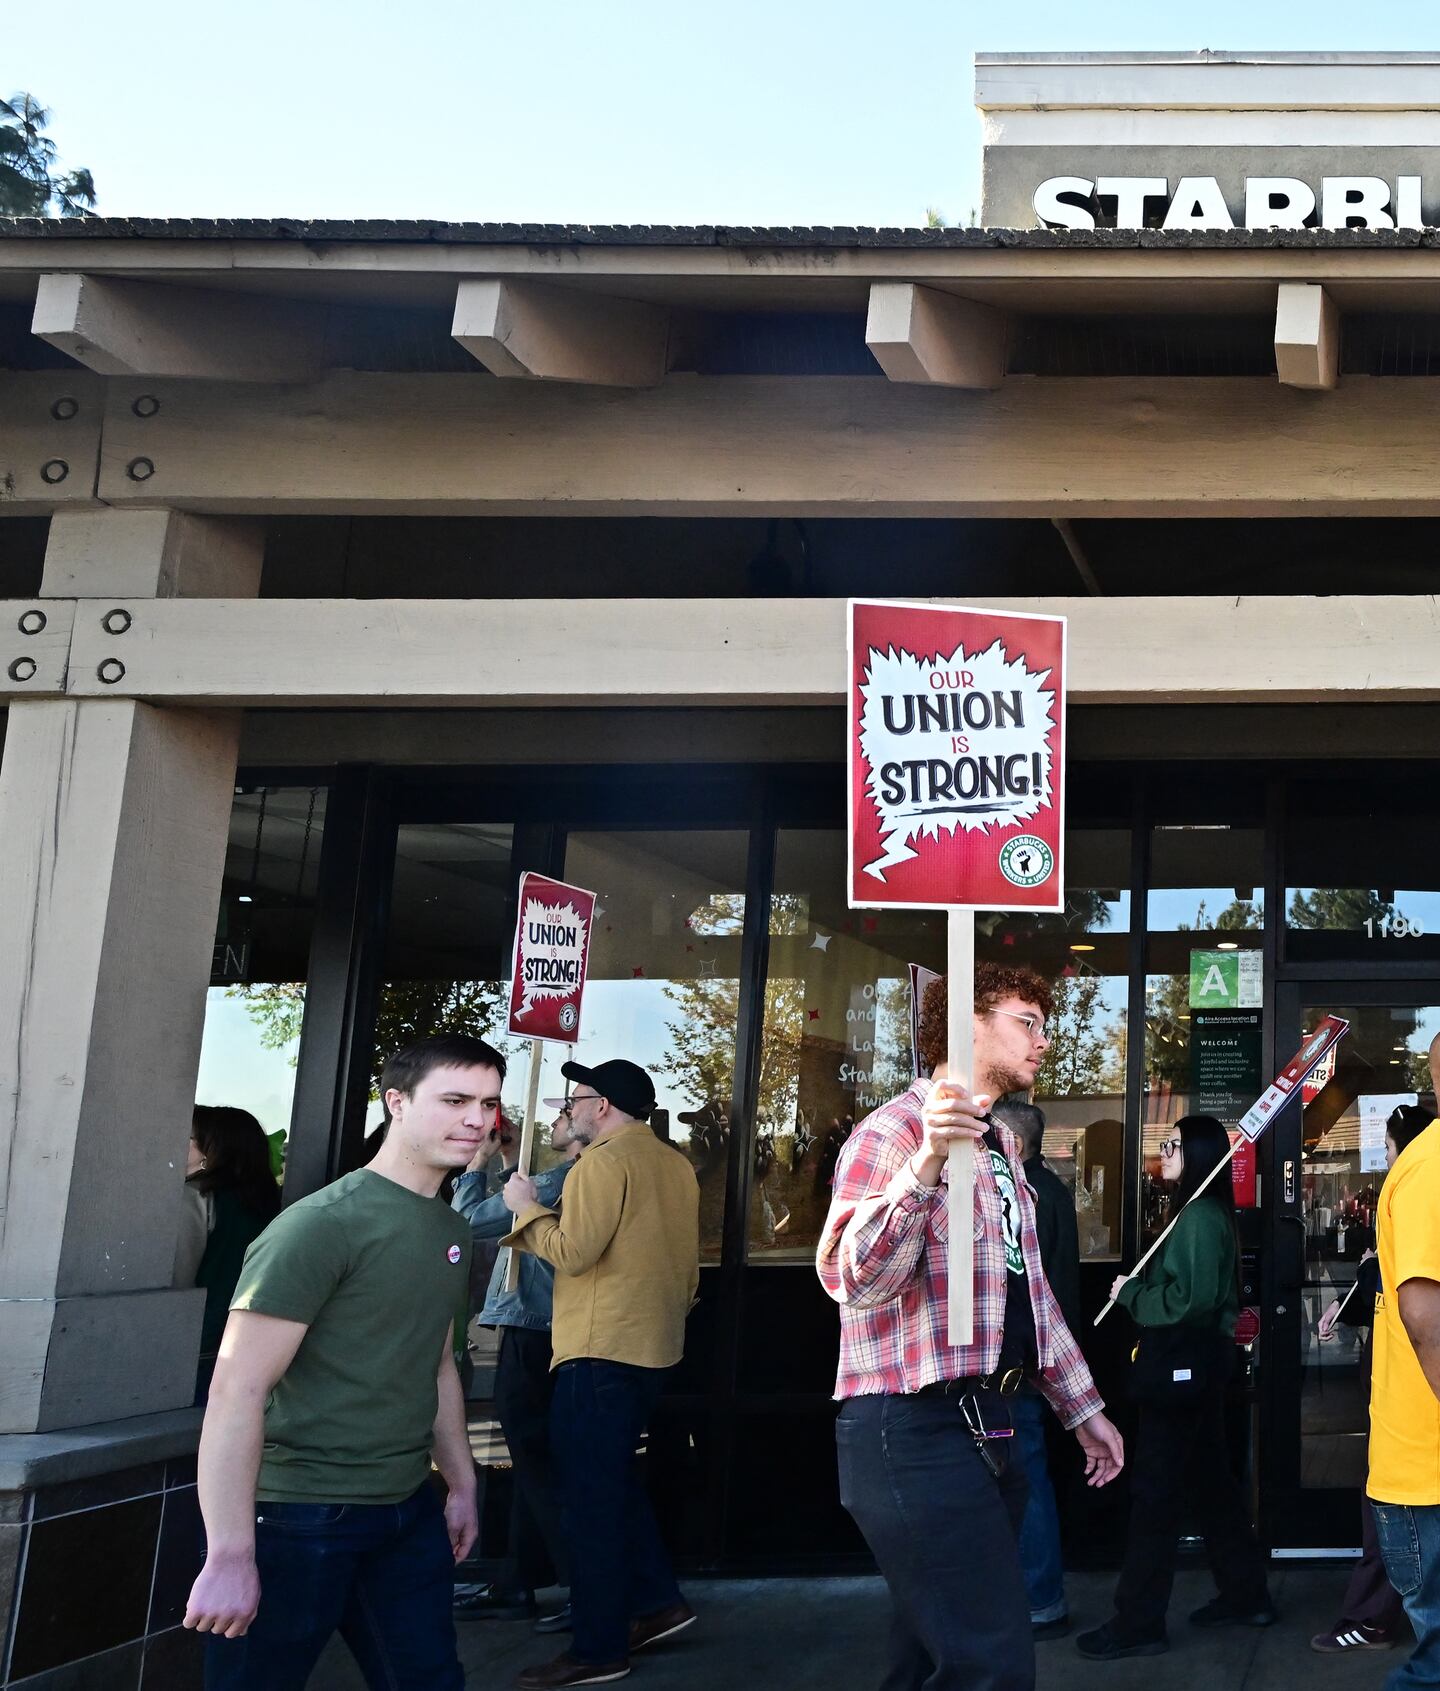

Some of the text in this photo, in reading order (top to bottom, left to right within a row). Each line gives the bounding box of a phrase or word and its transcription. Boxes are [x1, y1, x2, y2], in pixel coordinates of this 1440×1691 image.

[929, 670, 974, 689] OUR
[880, 690, 1025, 735] UNION
[952, 735, 970, 754] IS
[880, 751, 1042, 806] STRONG!
[1006, 838, 1047, 853] STARBUCKS
[1002, 858, 1027, 884] WORKERS
[1033, 860, 1050, 882] UNITED
[546, 912, 562, 924] OUR
[1363, 917, 1425, 938] 1190
[529, 922, 577, 947] UNION
[550, 947, 557, 958] IS
[525, 957, 579, 984] STRONG!
[1199, 964, 1229, 996] A
